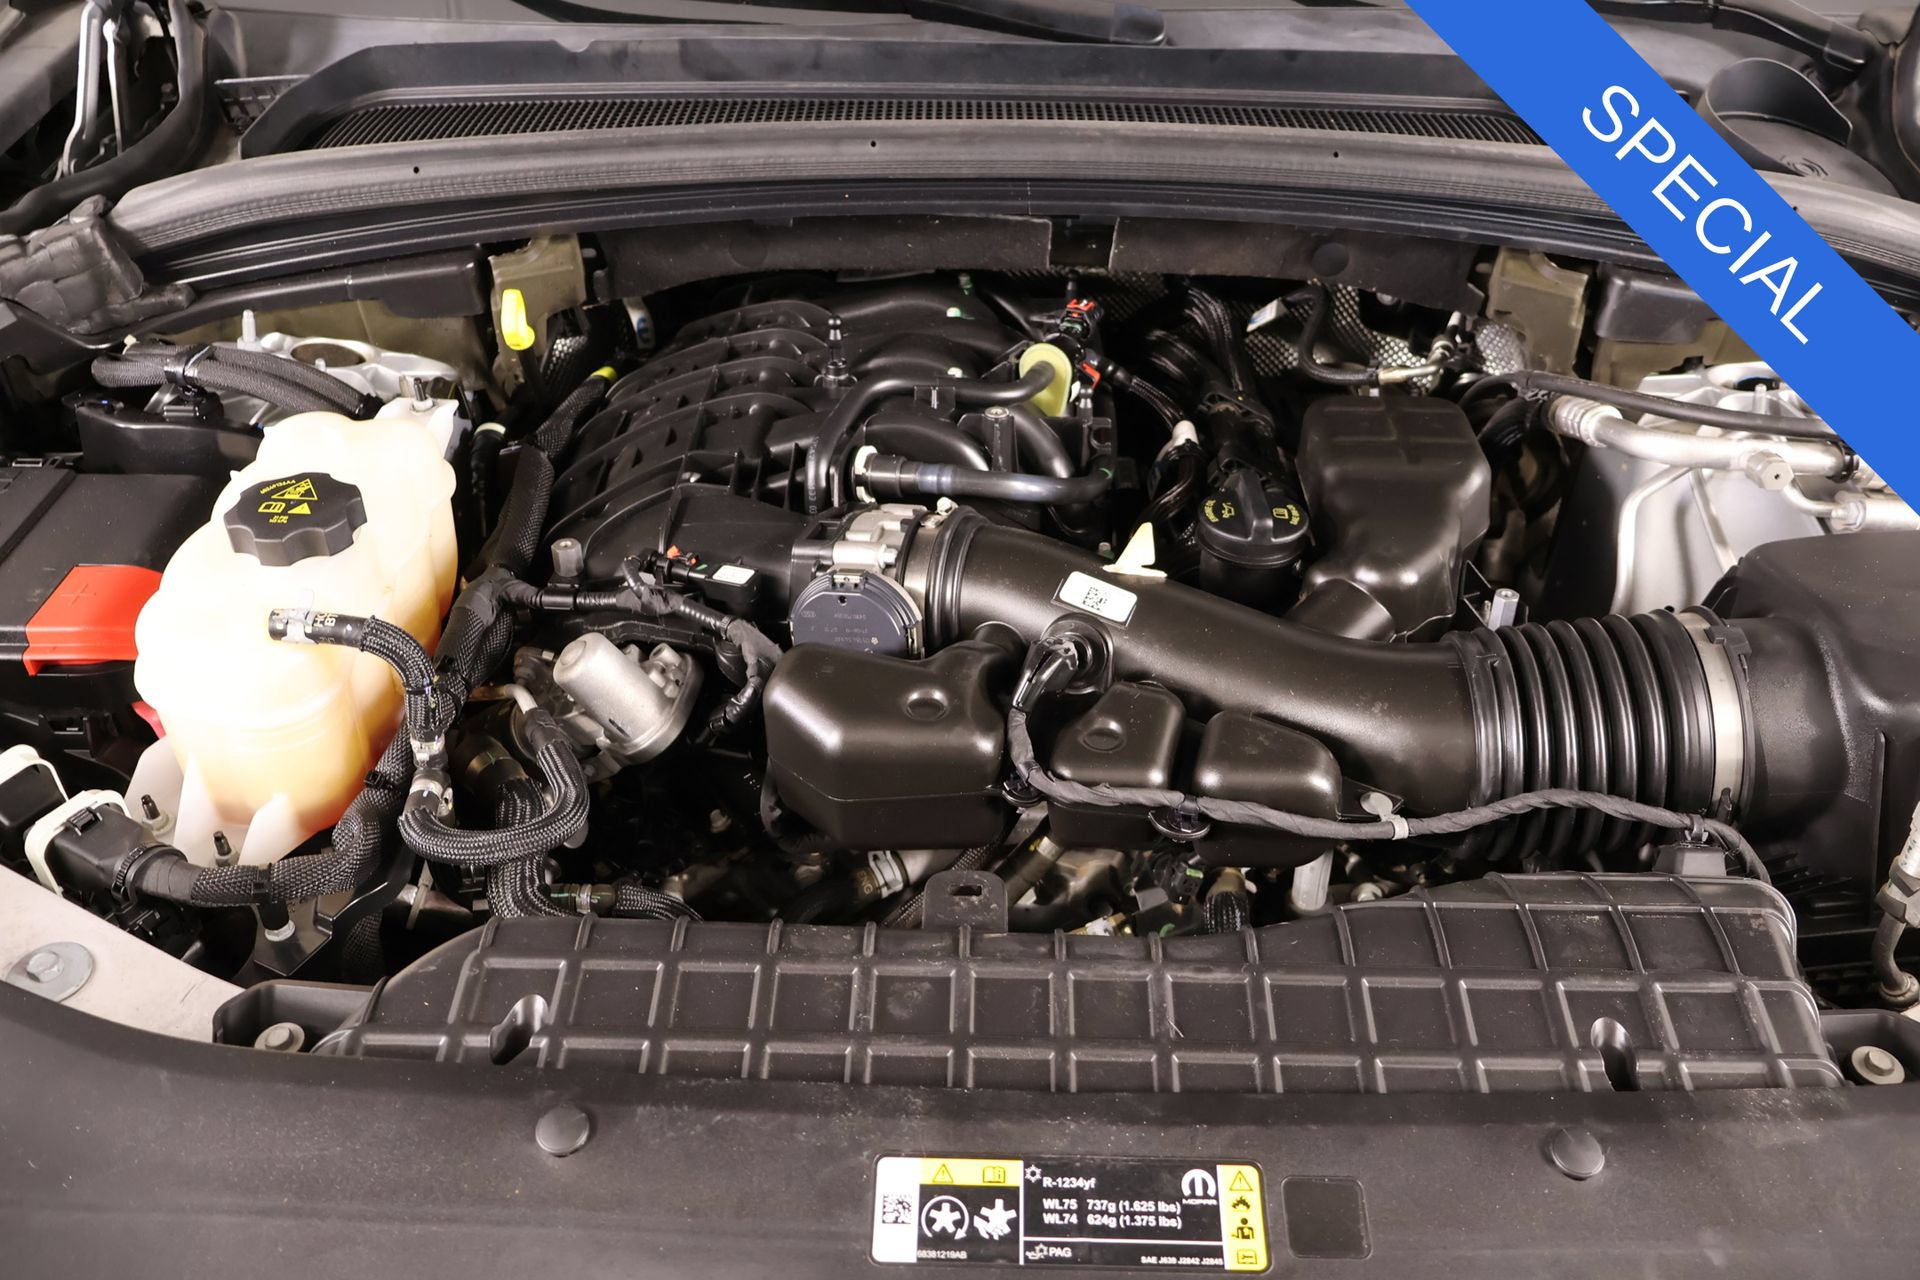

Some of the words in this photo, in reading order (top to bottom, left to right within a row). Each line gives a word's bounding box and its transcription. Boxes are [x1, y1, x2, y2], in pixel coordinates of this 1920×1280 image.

[1042, 1176, 1096, 1190] R-1234yf
[1042, 1198, 1078, 1210] WL75
[1086, 1199, 1116, 1213] 737g
[1119, 1200, 1156, 1213] (1.625
[1157, 1201, 1181, 1215] lbs)
[1042, 1213, 1078, 1224] WL74
[1086, 1214, 1117, 1228] 624g
[1119, 1215, 1157, 1228] (1.375
[1158, 1216, 1182, 1230] lbs)
[1048, 1247, 1073, 1258] PAG
